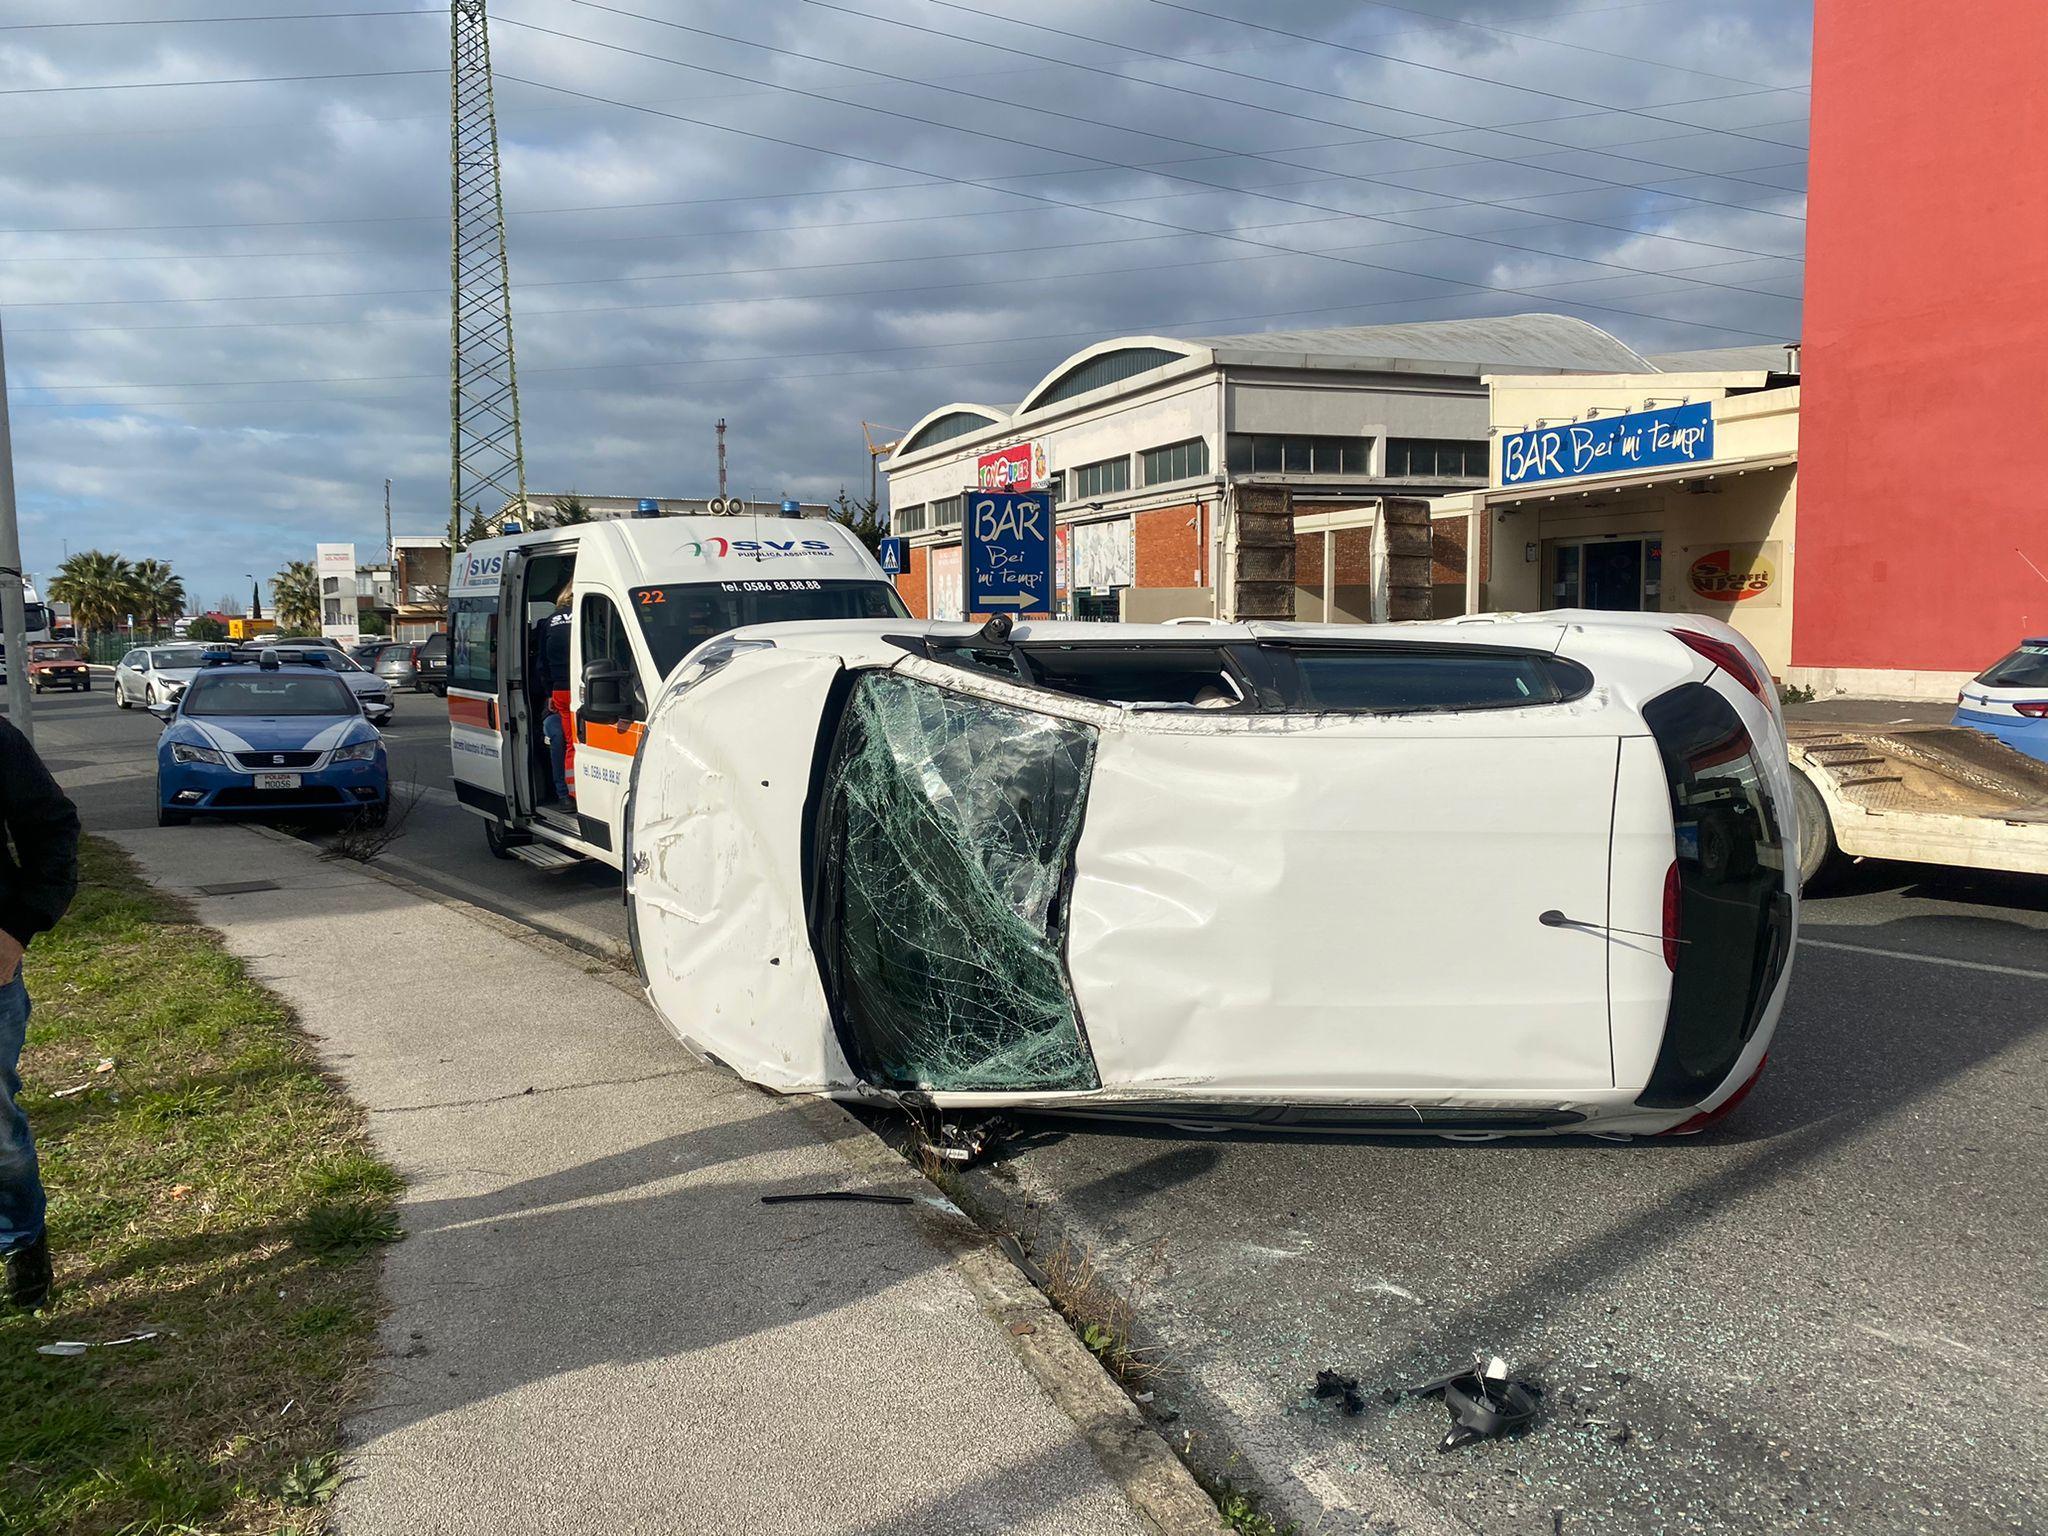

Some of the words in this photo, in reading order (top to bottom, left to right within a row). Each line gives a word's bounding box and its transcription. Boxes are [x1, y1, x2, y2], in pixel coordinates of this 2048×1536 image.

[1506, 432, 1564, 480] BAR
[1570, 428, 1614, 473] Bei
[1648, 419, 1708, 458] tempi
[975, 500, 1044, 542] BAR
[731, 540, 830, 551] SVS
[470, 556, 502, 576] SVS
[986, 545, 1025, 568] Bei
[721, 581, 742, 592] tel.
[744, 581, 772, 592] 0586
[774, 580, 821, 591] 88.88.88
[999, 568, 1043, 588] tempi
[638, 590, 666, 604] 22
[551, 613, 573, 623] SV
